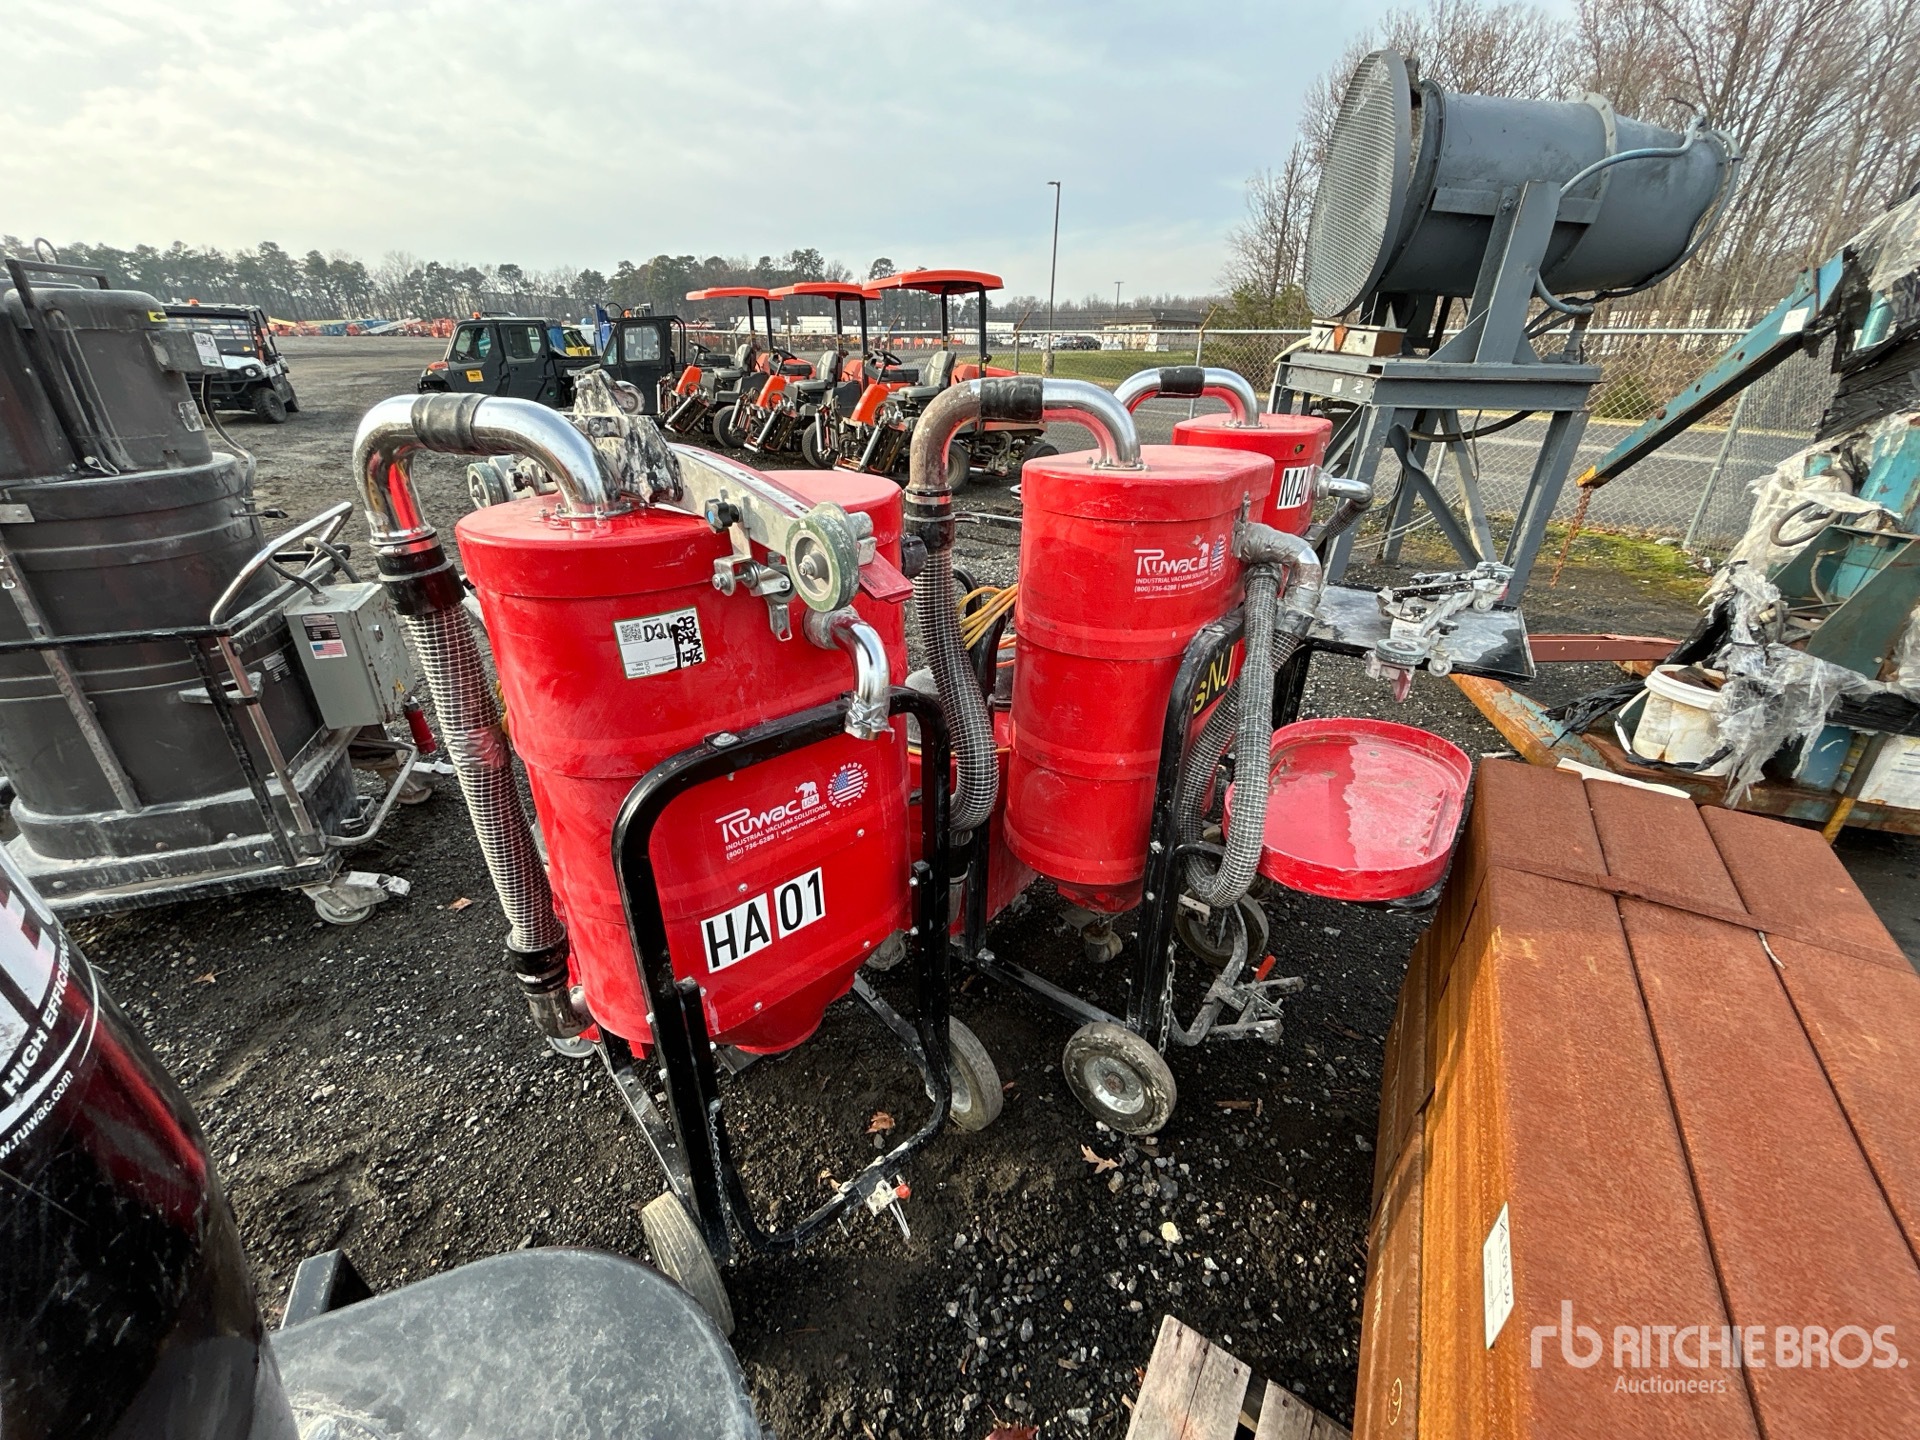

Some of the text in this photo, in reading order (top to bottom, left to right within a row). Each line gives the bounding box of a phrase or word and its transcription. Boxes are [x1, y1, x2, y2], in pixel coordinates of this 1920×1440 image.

[1134, 585, 1150, 593] (800)
[1135, 576, 1171, 585] INDUSTRIAL
[1171, 573, 1192, 582] VACUUM
[840, 762, 863, 772] MADE
[803, 796, 818, 808] USA
[725, 803, 828, 851] INDUSTRIAL VACUUM SOLUTIONS
[726, 810, 831, 861] (800) 736-6288 www.ruwac.com
[706, 901, 770, 968] HA
[2, 1026, 50, 1098] HIGH
